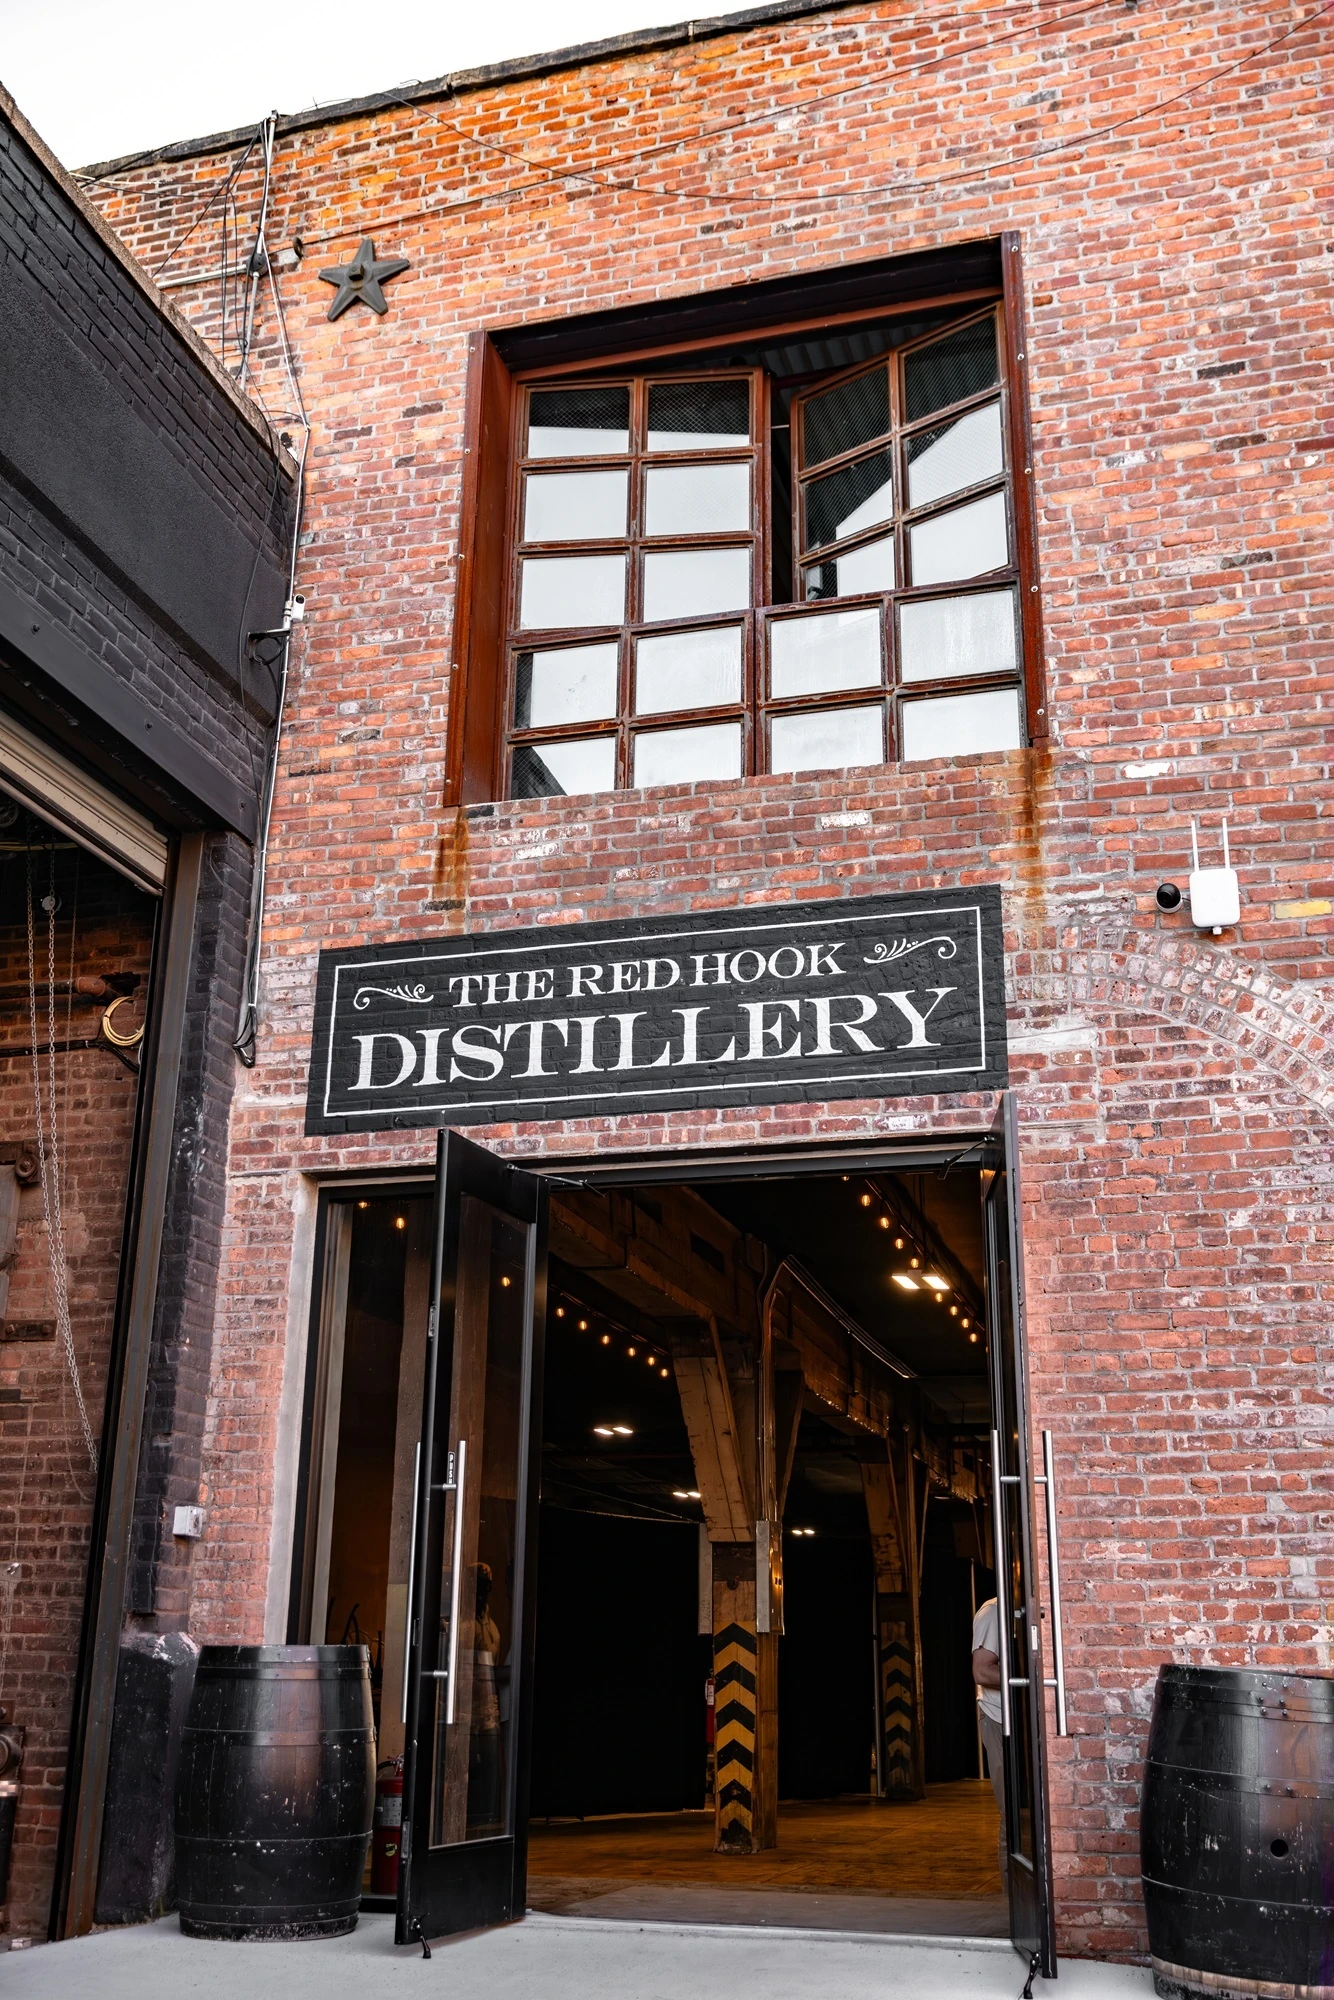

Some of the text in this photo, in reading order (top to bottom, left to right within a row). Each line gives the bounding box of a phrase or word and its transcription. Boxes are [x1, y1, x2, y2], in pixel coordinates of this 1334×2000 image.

[449, 943, 847, 1007] THE RED HOOK
[348, 987, 957, 1091] DISTILLERY
